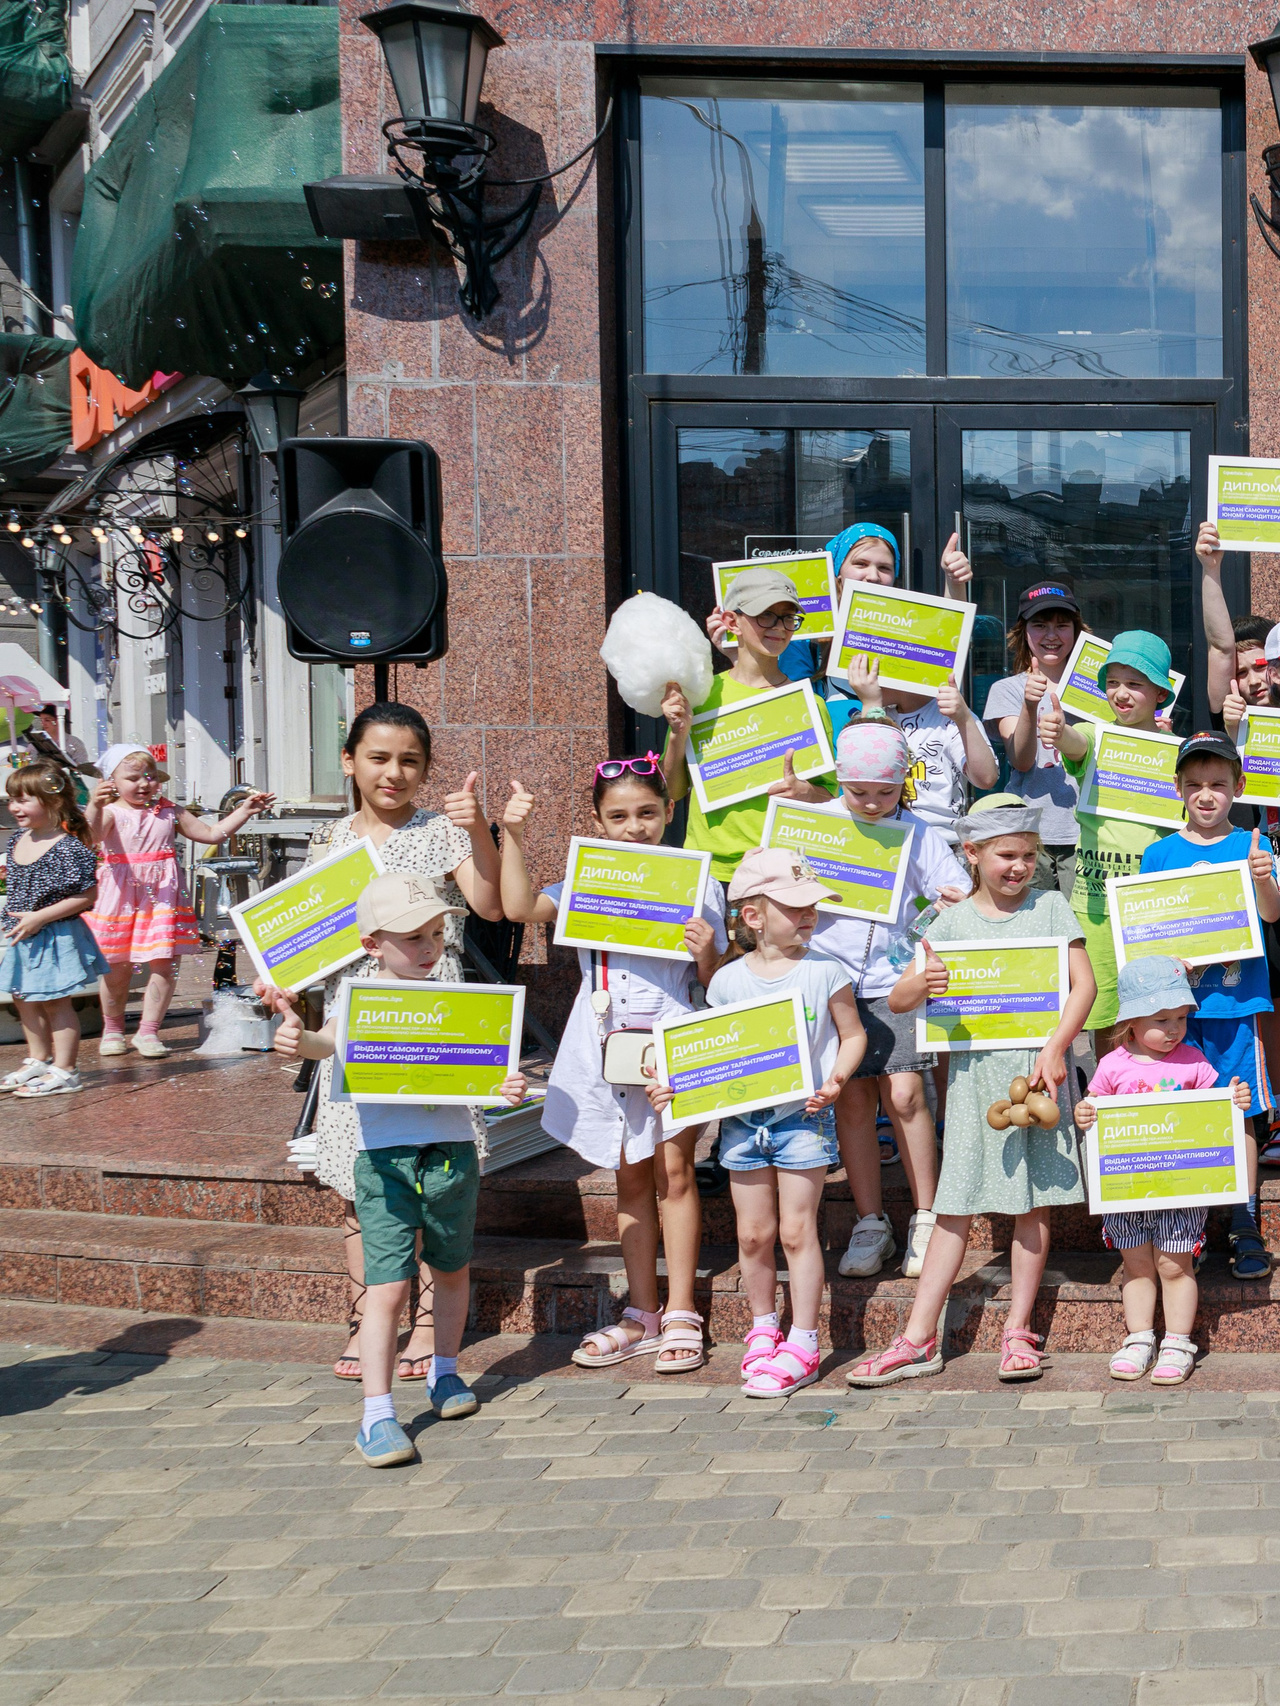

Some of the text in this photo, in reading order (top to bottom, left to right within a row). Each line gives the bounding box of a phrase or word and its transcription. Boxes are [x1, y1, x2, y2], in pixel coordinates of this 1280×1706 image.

[1028, 587, 1065, 600] PRINCESS
[852, 608, 913, 628] ДИПЛОМ
[847, 640, 906, 656] ЮНОМУ КОНДИТЕРУ
[848, 633, 945, 657] ВЫДАН САМОМУ ТАЛАНТЛИВОМУ
[698, 722, 758, 752] ДИПЛОМ
[704, 735, 803, 771] ВЫДАН САМОМУ ТАЛАНТЛИВОМУ
[1102, 748, 1164, 767] ДИПЛОМ
[706, 753, 766, 777] ЮНОМУ КОНДИТЕРУ
[777, 825, 846, 846] ДИПЛОМ
[580, 866, 645, 883] ДИПЛОМ
[829, 864, 882, 878] ТАЛАНТЛИВОМУ
[404, 880, 434, 904] A
[600, 899, 627, 907] САМОМУ
[629, 902, 680, 914] ТАЛАНТЛИВОМУ
[600, 906, 638, 916] КОНДИТЕРУ
[1124, 894, 1189, 914] ДИПЛОМ
[257, 893, 322, 937] ДИПЛОМ
[268, 925, 320, 958] ВЫДАН САМОМУ
[271, 925, 335, 964] ЮНОМУ КОНДИТЕРУ
[356, 1010, 444, 1024] ДИПЛОМ
[672, 1031, 739, 1060] ДИПЛОМ
[674, 1051, 785, 1083] ВЫДАН САМОМУ ТАЛАНТЛИВОМУ
[675, 1068, 743, 1090] ЮНОМУ КОНДИТЕРУ
[1103, 1122, 1174, 1140] ДИПЛОМ
[1163, 1151, 1220, 1160] ТАЛАНТЛИВОМУ
